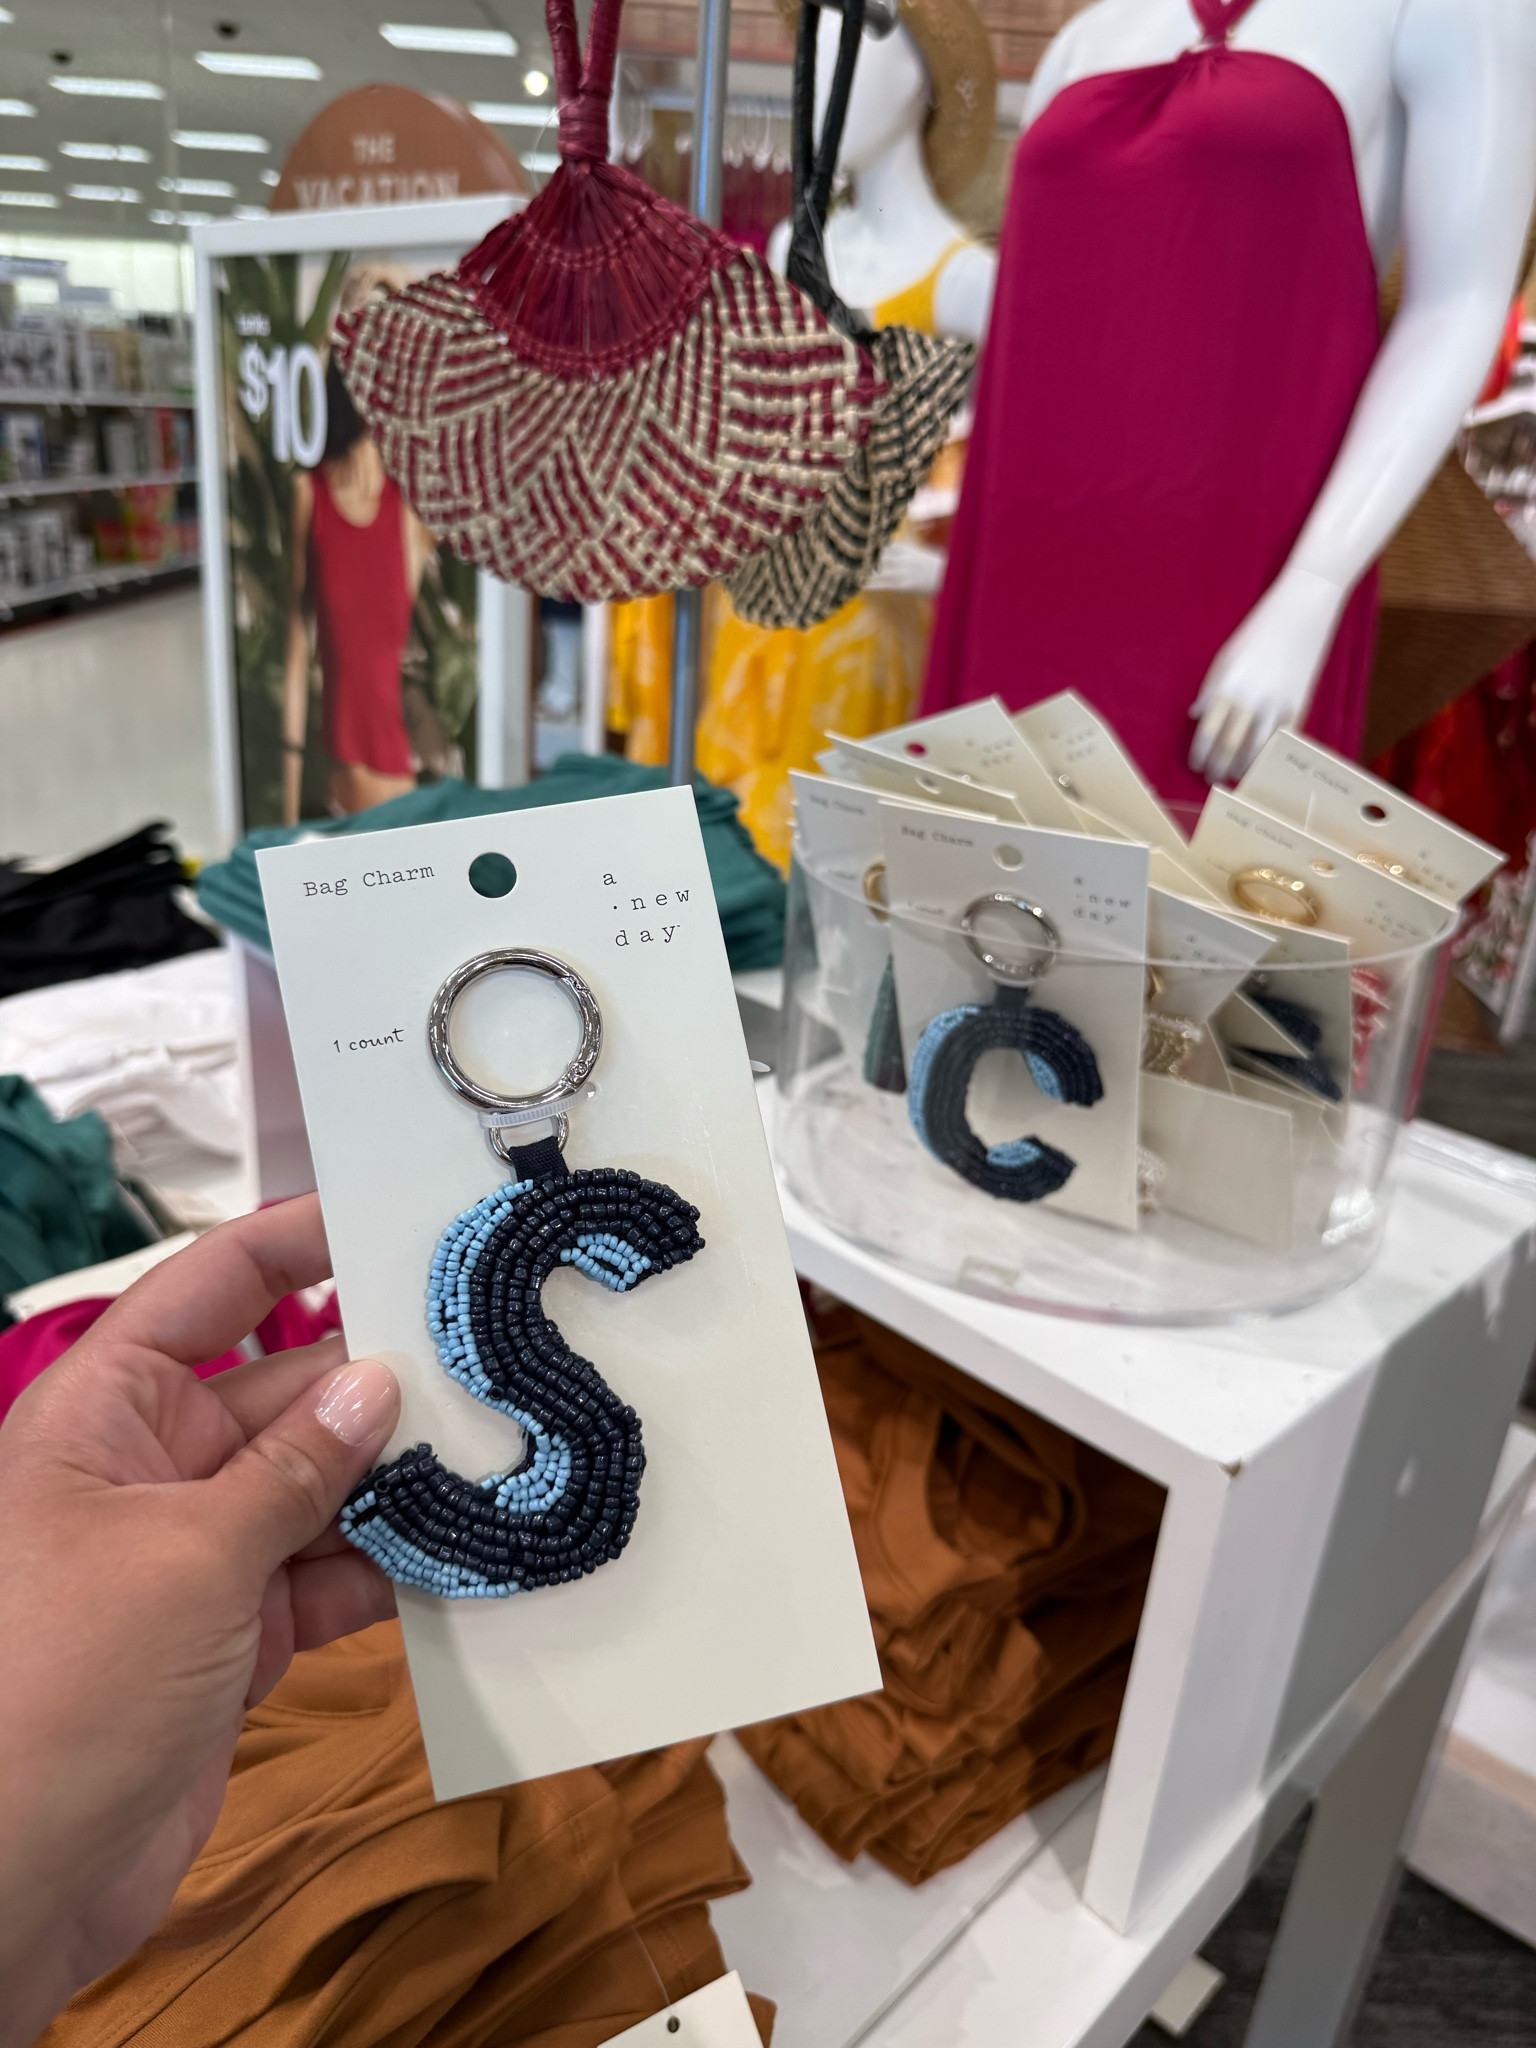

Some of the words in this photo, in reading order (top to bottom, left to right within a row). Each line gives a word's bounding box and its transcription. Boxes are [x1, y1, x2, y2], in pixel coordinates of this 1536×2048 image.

[352, 133, 396, 163] THE
[294, 171, 460, 210] VACATION
[239, 341, 328, 468] $10
[901, 826, 926, 841] Bag
[931, 832, 974, 849] Charm
[303, 878, 349, 897] Bag
[362, 866, 436, 887] Charm
[602, 873, 617, 886] a
[333, 1039, 341, 1053] 1
[349, 1028, 404, 1051] count
[340, 1168, 706, 1599] S
